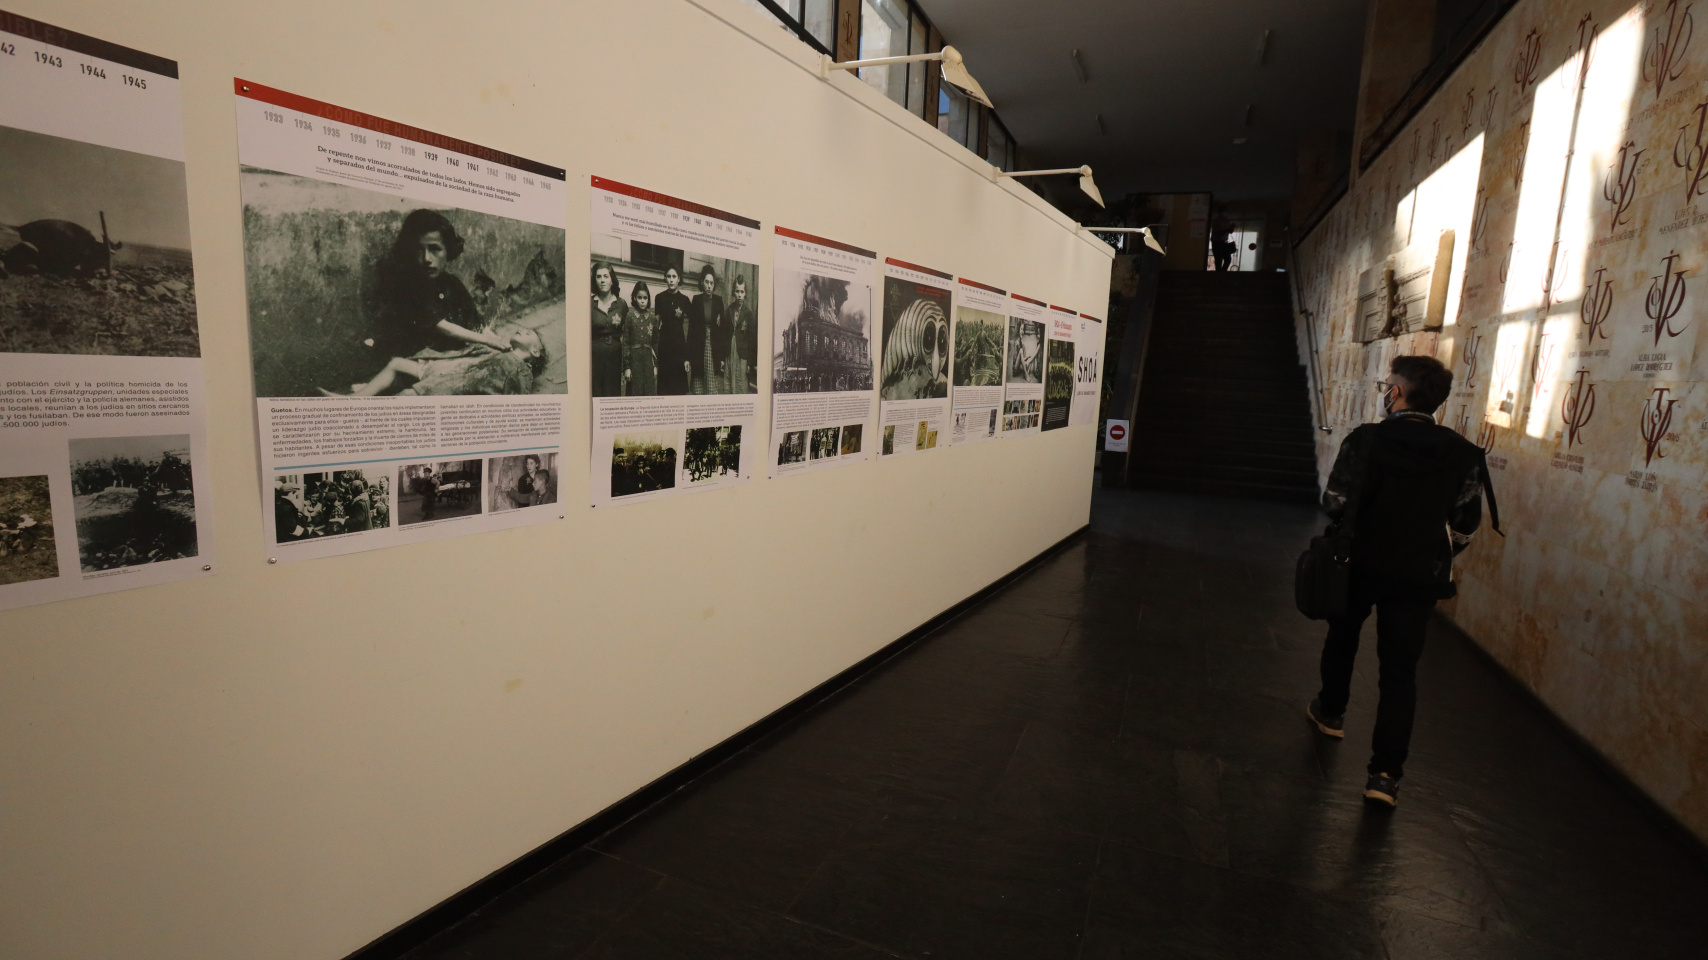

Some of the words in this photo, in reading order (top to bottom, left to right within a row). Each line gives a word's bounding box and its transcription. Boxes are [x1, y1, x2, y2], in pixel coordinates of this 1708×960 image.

[34, 51, 63, 68] 1943
[80, 63, 107, 80] 1944
[122, 74, 147, 90] 1945
[264, 110, 284, 124] 1933
[294, 118, 313, 132] 1934
[322, 125, 341, 139] 1935
[424, 151, 438, 162] 1939
[446, 156, 460, 167] 1940
[467, 162, 479, 173] 1941
[317, 145, 327, 153] De
[328, 148, 354, 161] repente
[355, 155, 366, 163] nos
[367, 157, 386, 167] vimos
[387, 161, 421, 175] acorralados
[421, 168, 429, 176] de
[429, 171, 444, 180] todos
[444, 174, 452, 182] los
[468, 180, 485, 190] Hemos
[486, 184, 496, 192] sido
[333, 158, 365, 171] separados
[365, 164, 376, 172] del
[403, 174, 435, 186] expulsados
[435, 178, 442, 186] de
[448, 183, 470, 194] sociedad
[478, 188, 483, 196] la
[483, 191, 494, 199] raza
[1078, 351, 1098, 383] SHOÁ
[6, 380, 49, 388] población
[96, 380, 125, 388] política
[44, 396, 75, 404] ejército
[49, 388, 115, 397] Einsatzgruppen,
[151, 388, 189, 396] especiales
[41, 420, 70, 428] judíos.
